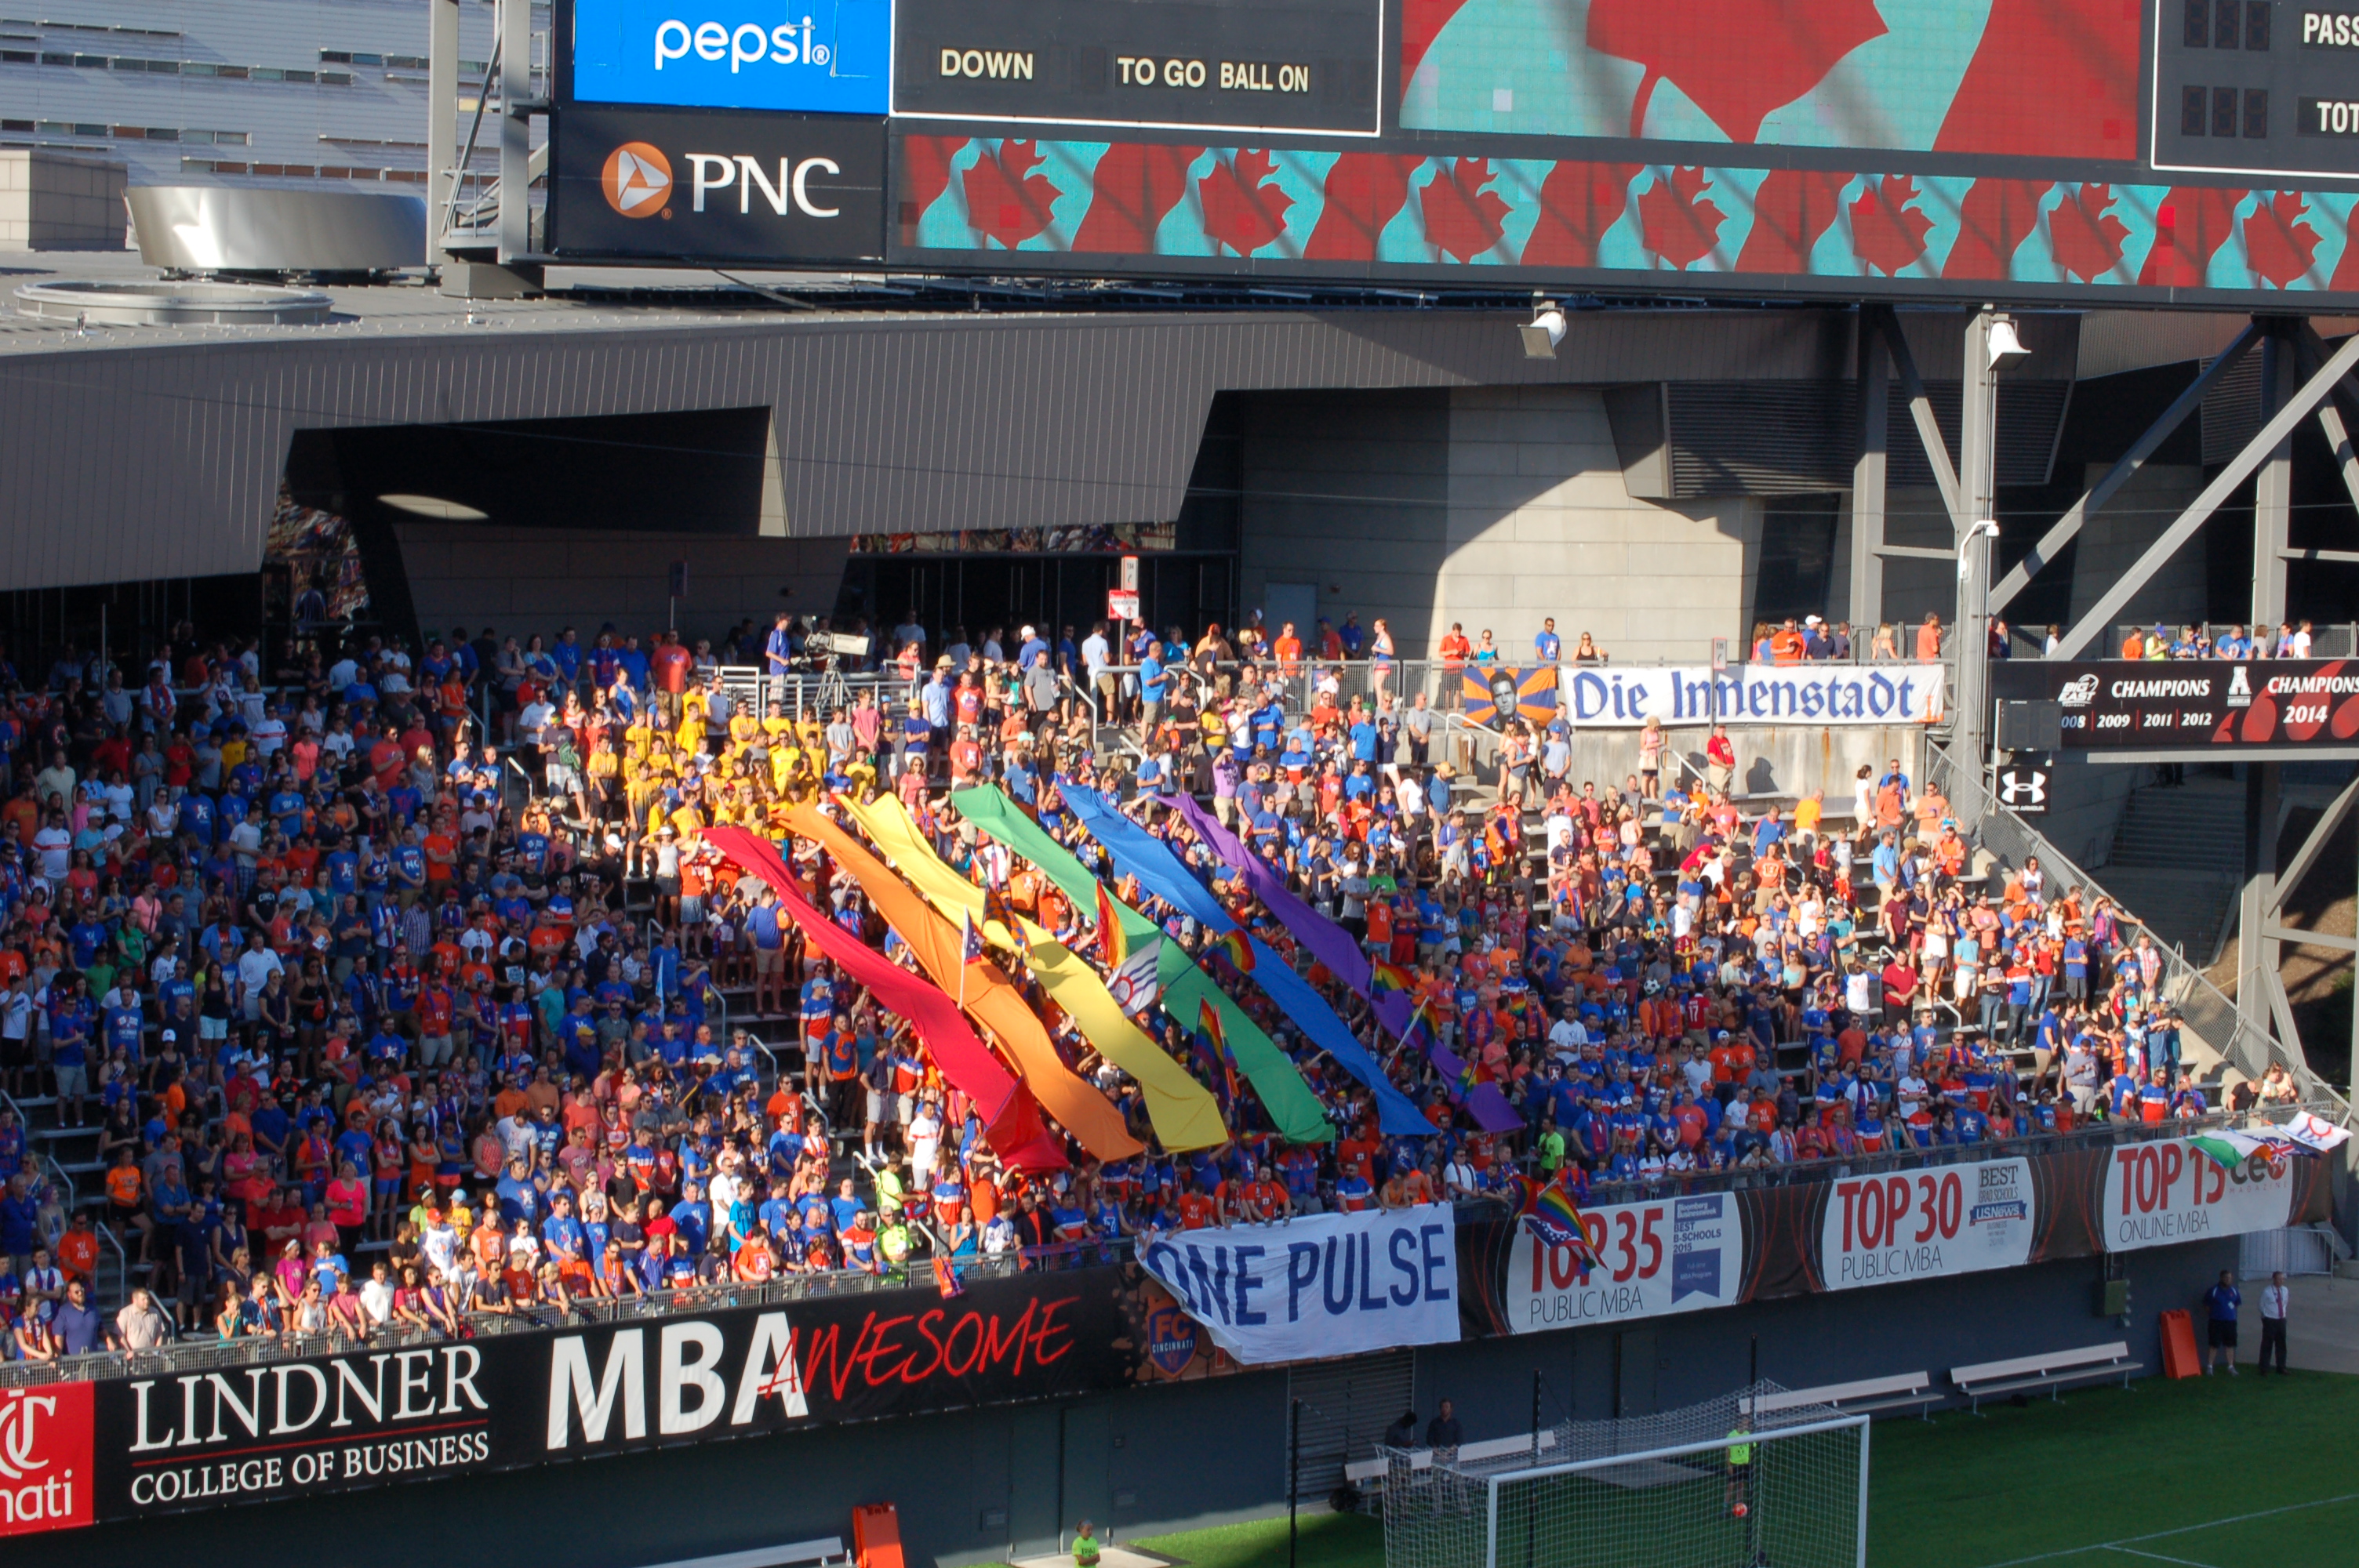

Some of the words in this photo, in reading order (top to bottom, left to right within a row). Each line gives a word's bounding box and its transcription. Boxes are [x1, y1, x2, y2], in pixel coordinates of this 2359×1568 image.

[654, 16, 814, 74] pepsi
[940, 49, 1034, 80] DOWN
[1117, 56, 1156, 85] TO
[1164, 60, 1206, 89] GO
[1220, 62, 1274, 90] BALL
[1279, 65, 1309, 93] ON
[685, 153, 840, 218] PNC
[1573, 670, 1648, 720] Die
[1671, 670, 1914, 719] Innenstadt
[2057, 691, 2096, 702] EAST
[2063, 681, 2089, 692] BIG
[2111, 679, 2211, 698] CHAMPIONS
[2061, 715, 2086, 729] 008
[2096, 714, 2131, 728] 2009
[2143, 713, 2172, 728] 2011
[2181, 713, 2212, 726] 2012
[2283, 705, 2328, 724] 2014
[1688, 1005, 1699, 1022] 17
[1979, 1165, 2019, 1187] BEST
[2117, 1143, 2183, 1215] TOP
[2188, 1146, 2226, 1205] 15
[2229, 1181, 2288, 1194] MAGAZINE
[1674, 1222, 1696, 1232] BEST
[1837, 1176, 1911, 1253] TOP
[1914, 1171, 1962, 1243] 30
[2120, 1215, 2174, 1243] ONLINE
[2177, 1210, 2209, 1235] MBA
[1613, 1207, 1663, 1282] 35
[1673, 1243, 1692, 1253] 2015
[1674, 1229, 1721, 1243] B-SCHOOLS
[1146, 1241, 1267, 1326] ONE
[1288, 1224, 1450, 1323] PULSE
[1841, 1250, 1900, 1282] PUBLIC
[1904, 1245, 1943, 1273] MBA
[1530, 1291, 1596, 1324] PUBLIC
[1601, 1286, 1643, 1316] MBA
[1156, 1312, 1190, 1342] FC
[1152, 1339, 1193, 1354] CINCINNATI
[547, 1311, 809, 1450] MBA
[757, 1296, 1081, 1401] AWESOME
[129, 1345, 488, 1452] LINDNER
[131, 1457, 283, 1504] COLLEGE
[291, 1450, 333, 1484] OF
[343, 1431, 489, 1475] BUSINESS
